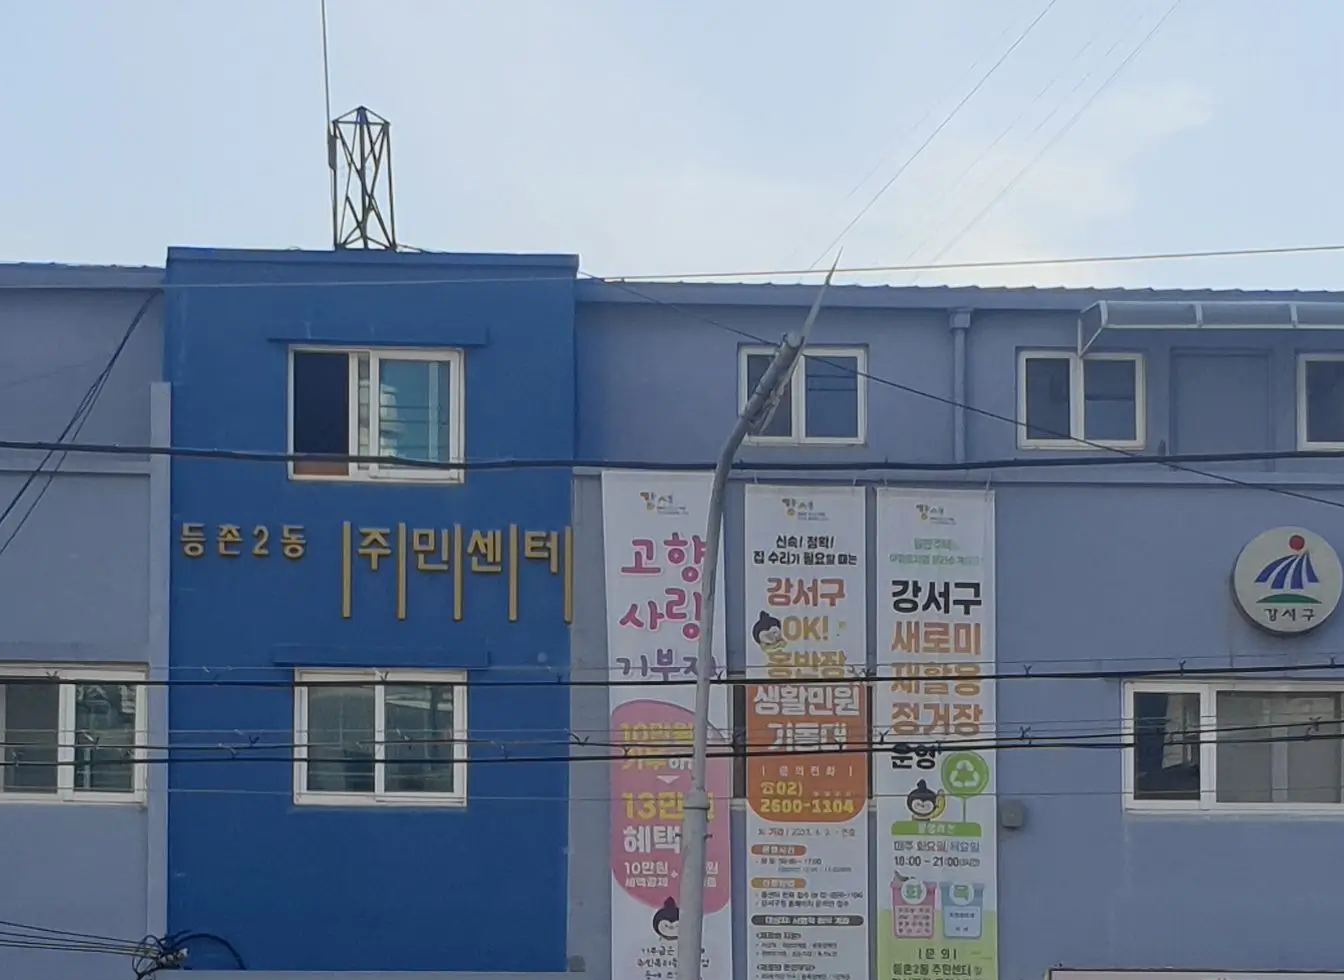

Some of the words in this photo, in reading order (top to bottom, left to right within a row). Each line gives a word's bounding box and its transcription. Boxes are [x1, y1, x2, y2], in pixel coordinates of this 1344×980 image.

[180, 523, 307, 559] 등촌2동
[358, 528, 559, 574] 주민센터
[767, 577, 846, 607] 강서구
[891, 580, 983, 616] 강서구
[782, 615, 829, 641] OK!
[1264, 608, 1315, 622] 강서구
[891, 621, 982, 656] 새로미
[753, 684, 861, 717] 생활민원
[891, 702, 984, 738] 정거장
[623, 824, 682, 854] 혜택
